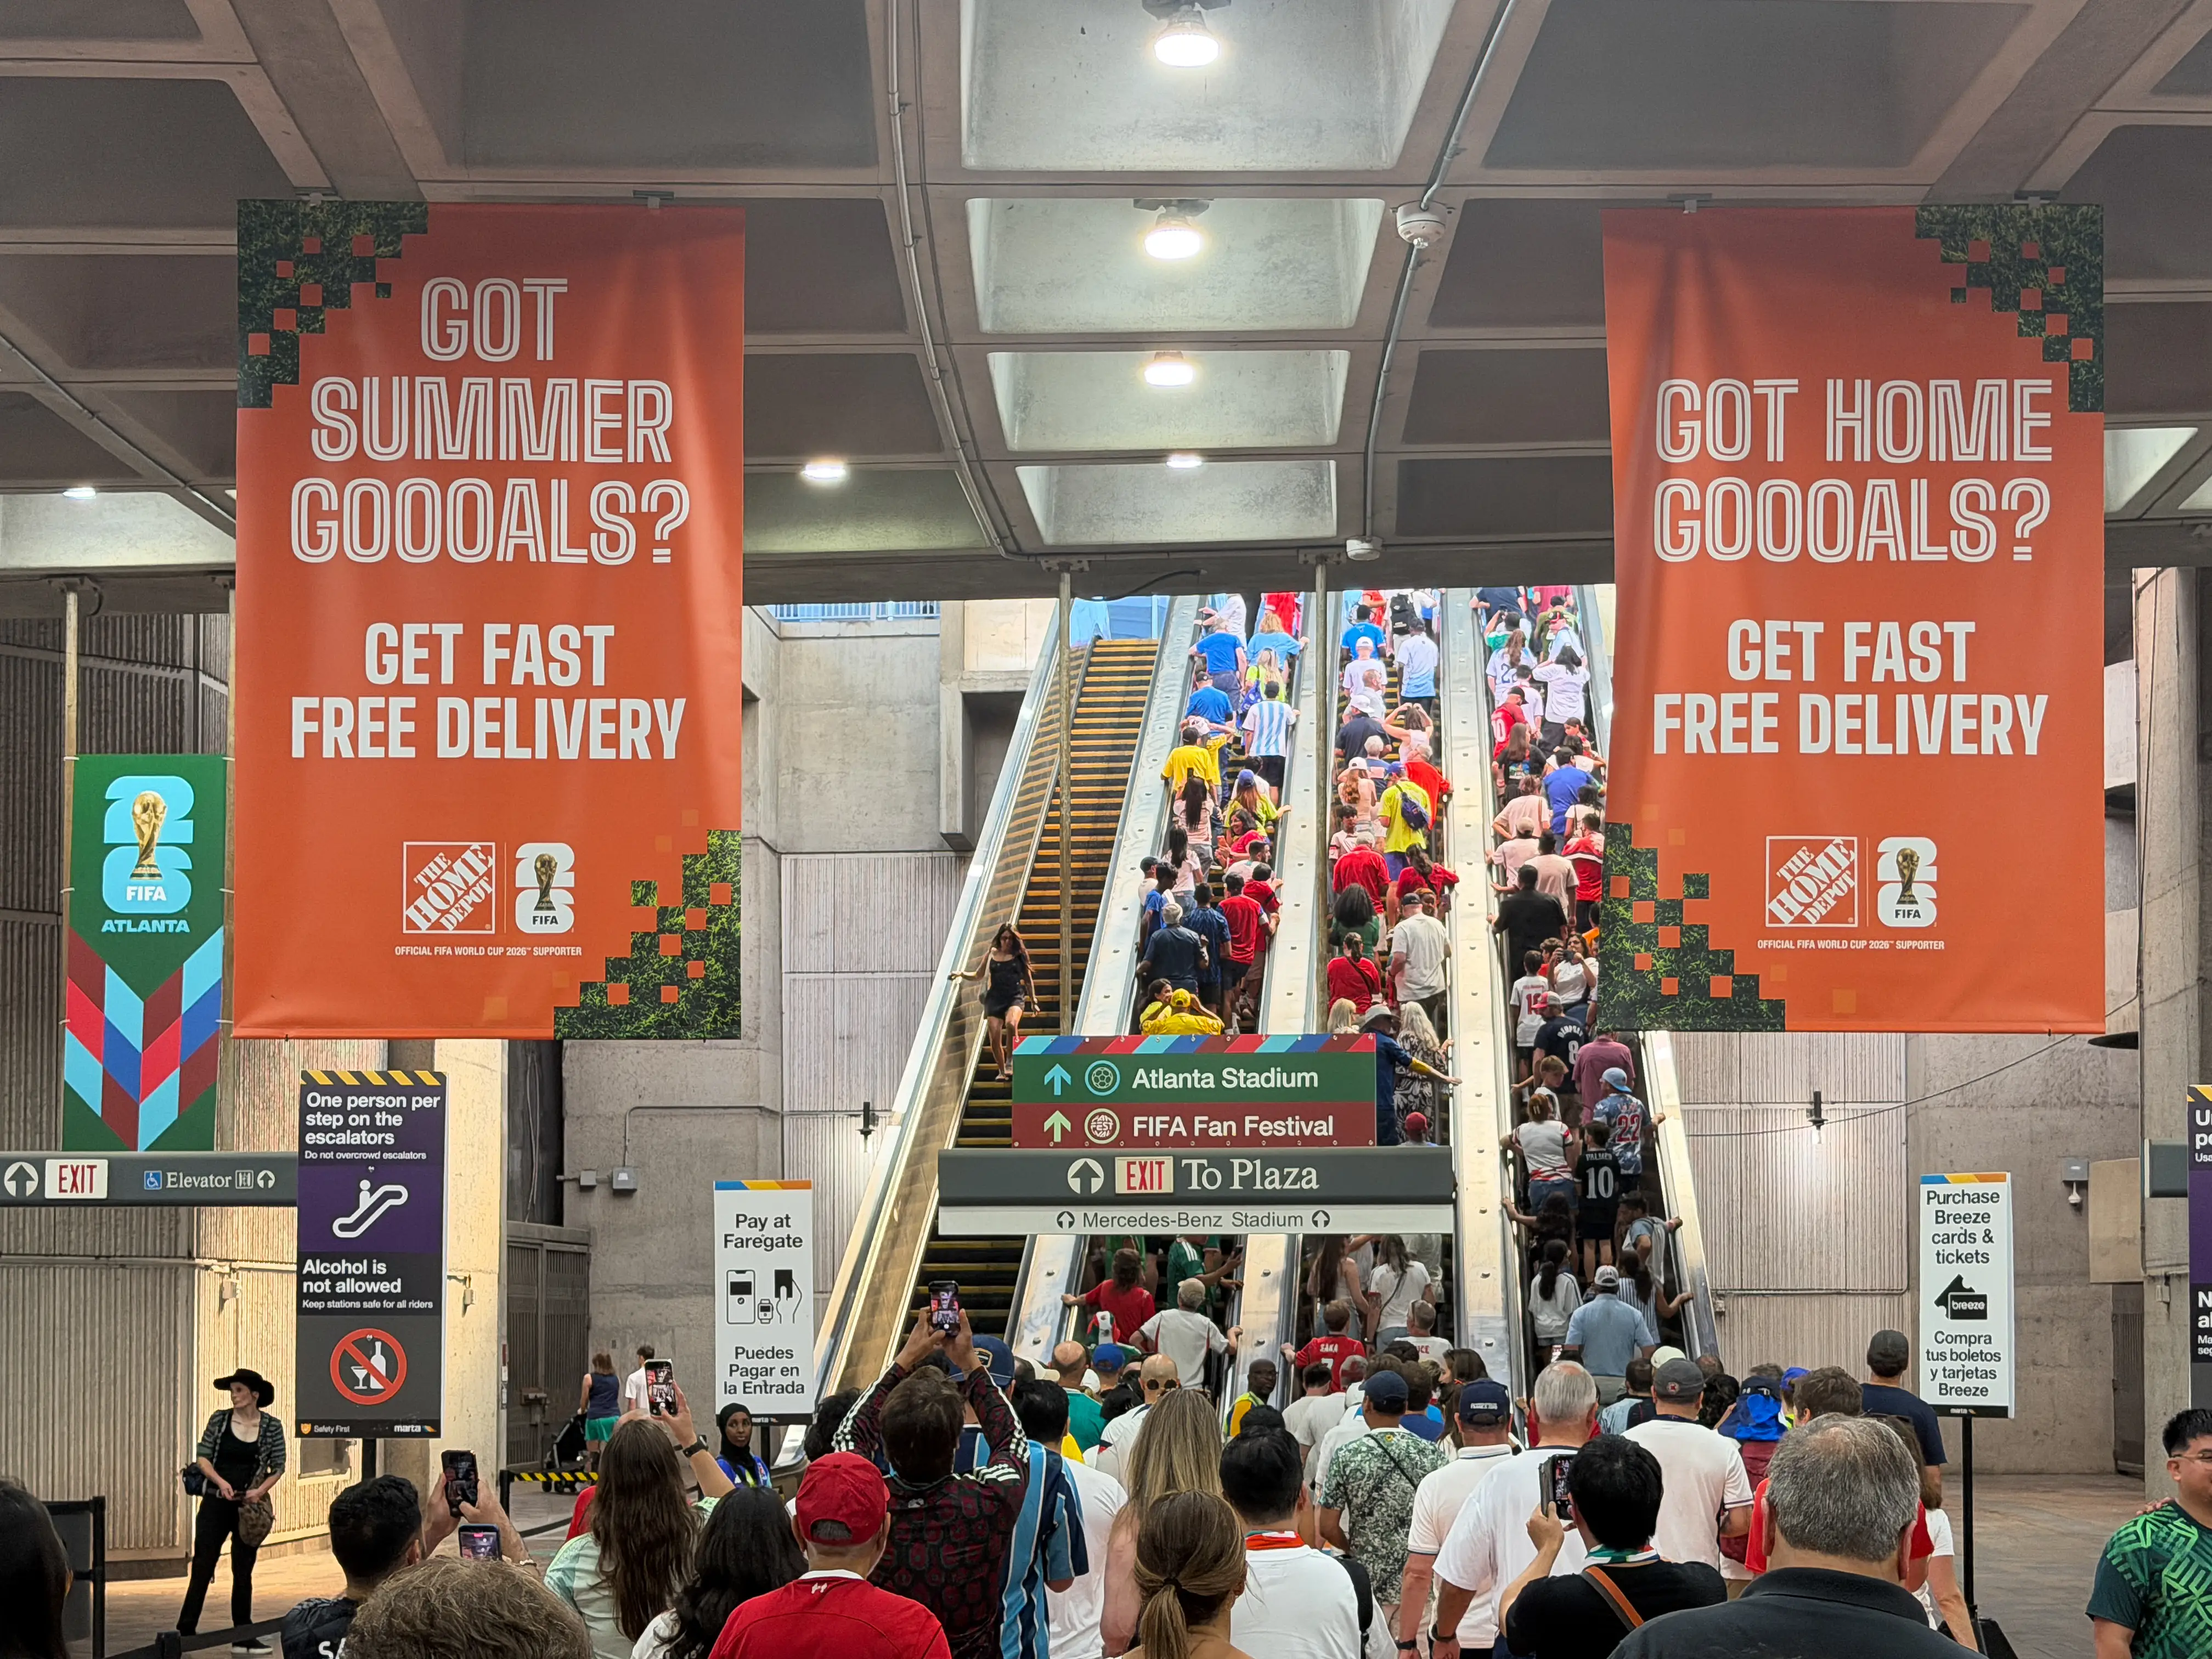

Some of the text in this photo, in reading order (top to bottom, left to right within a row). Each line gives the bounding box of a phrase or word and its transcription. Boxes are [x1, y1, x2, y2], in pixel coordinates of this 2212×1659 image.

[421, 277, 567, 362] GOT
[311, 376, 673, 462] SUMMER
[1656, 378, 2052, 463] GOT HOME
[291, 478, 690, 565] GOOOALS?
[1654, 477, 2051, 562] GOOOALS?
[365, 623, 614, 687] GET FAST
[1728, 619, 1976, 682] GET FAST
[291, 697, 686, 760] FREE DELIVERY
[1653, 693, 2049, 756] FREE DELIVERY
[413, 852, 452, 888] THE
[1776, 846, 1814, 882] THE
[405, 844, 493, 931] HOME
[1768, 838, 1855, 924] HOME
[126, 886, 167, 901] FIFA
[1802, 870, 1855, 924] DEPOT
[439, 876, 493, 932] DEPOT
[533, 916, 558, 924] FIFA
[1895, 910, 1921, 918] FIFA
[101, 919, 190, 934] ATLANTA
[395, 946, 432, 956] OFFICIAL
[435, 947, 452, 955] FIFA
[455, 947, 486, 956] WORLD
[487, 947, 504, 956] CUP
[533, 947, 582, 956] SUPPORTER
[1757, 939, 1795, 949] OFFICIAL
[1797, 940, 1815, 949] FIFA
[1818, 940, 1848, 949] WORLD
[1850, 940, 1866, 949] CUP
[1896, 940, 1944, 949] SUPPORTER
[1132, 1068, 1318, 1089] Atlanta Stadium
[307, 1092, 440, 1111] One person per
[306, 1111, 403, 1130] step on the
[1133, 1115, 1334, 1137] FIFA Fan Festival
[1616, 1114, 1640, 1143] 22
[305, 1130, 394, 1146] escalators
[305, 1150, 426, 1160] Do not overcrowd escalators
[59, 1165, 97, 1195] EXIT
[166, 1171, 232, 1190] Elevator
[1126, 1159, 1320, 1192] EXIT To Plaza
[1586, 1166, 1613, 1199] 10
[1927, 1189, 2000, 1205] Purchase
[736, 1214, 791, 1232] Pay at
[1082, 1212, 1303, 1228] Mercedes-Benz Stadium
[1935, 1210, 1990, 1224] Breeze
[724, 1234, 803, 1251] Faregate
[1932, 1228, 1994, 1244] cards &
[1936, 1249, 1990, 1264] tickets
[303, 1259, 386, 1275] Alcohol is
[303, 1278, 402, 1294] not allowed
[303, 1300, 433, 1310] Keep stations safe for all riders
[1952, 1300, 1985, 1310] breeze
[1934, 1331, 1992, 1346] Compra
[735, 1346, 794, 1359] Puedes
[1319, 1343, 1338, 1353] SAKA
[1926, 1348, 2001, 1362] tus boletos
[729, 1363, 799, 1380] Pagar en
[1930, 1367, 1997, 1382] y tarjetas
[724, 1381, 805, 1395] la Entrada
[1939, 1383, 1989, 1397] Breeze
[314, 1425, 334, 1434] Safety
